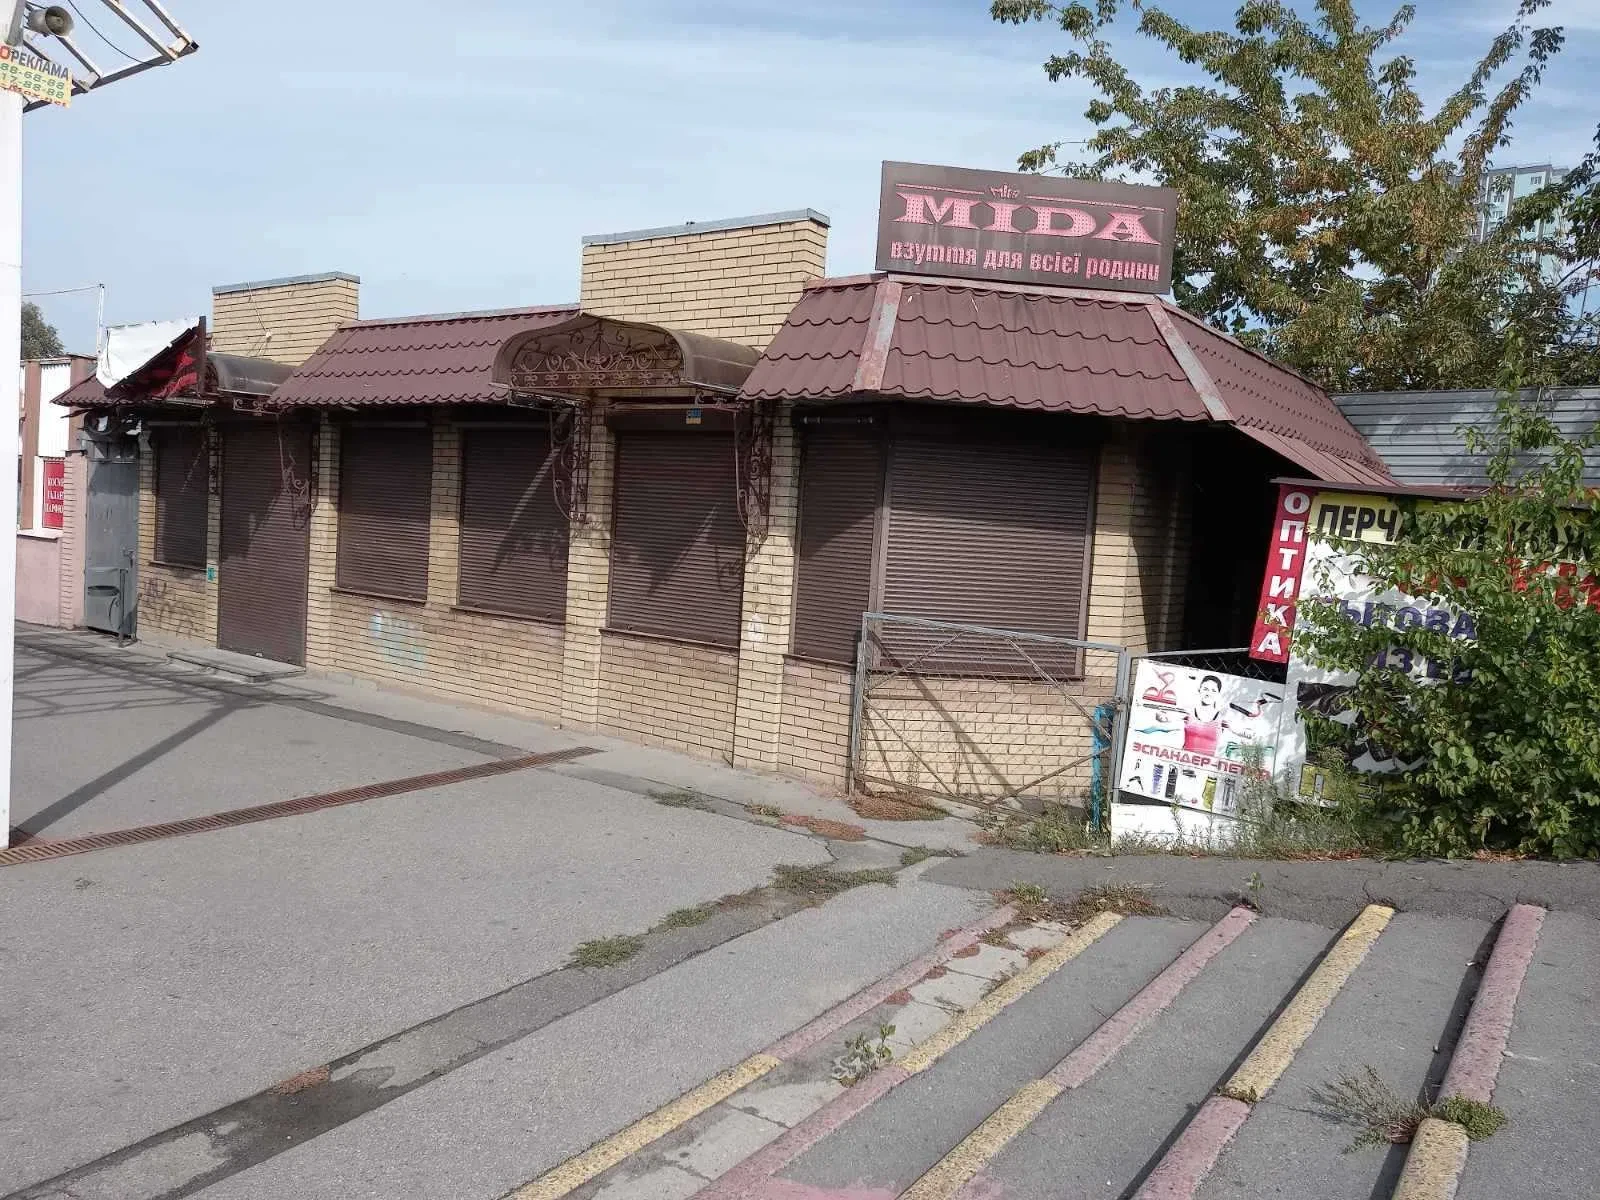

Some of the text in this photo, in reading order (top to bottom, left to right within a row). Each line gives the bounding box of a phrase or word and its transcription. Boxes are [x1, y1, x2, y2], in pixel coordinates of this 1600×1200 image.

[890, 191, 1162, 245] MIDA
[890, 240, 1161, 282] взуття для всієї родини
[1256, 491, 1311, 656] ОПТИКА
